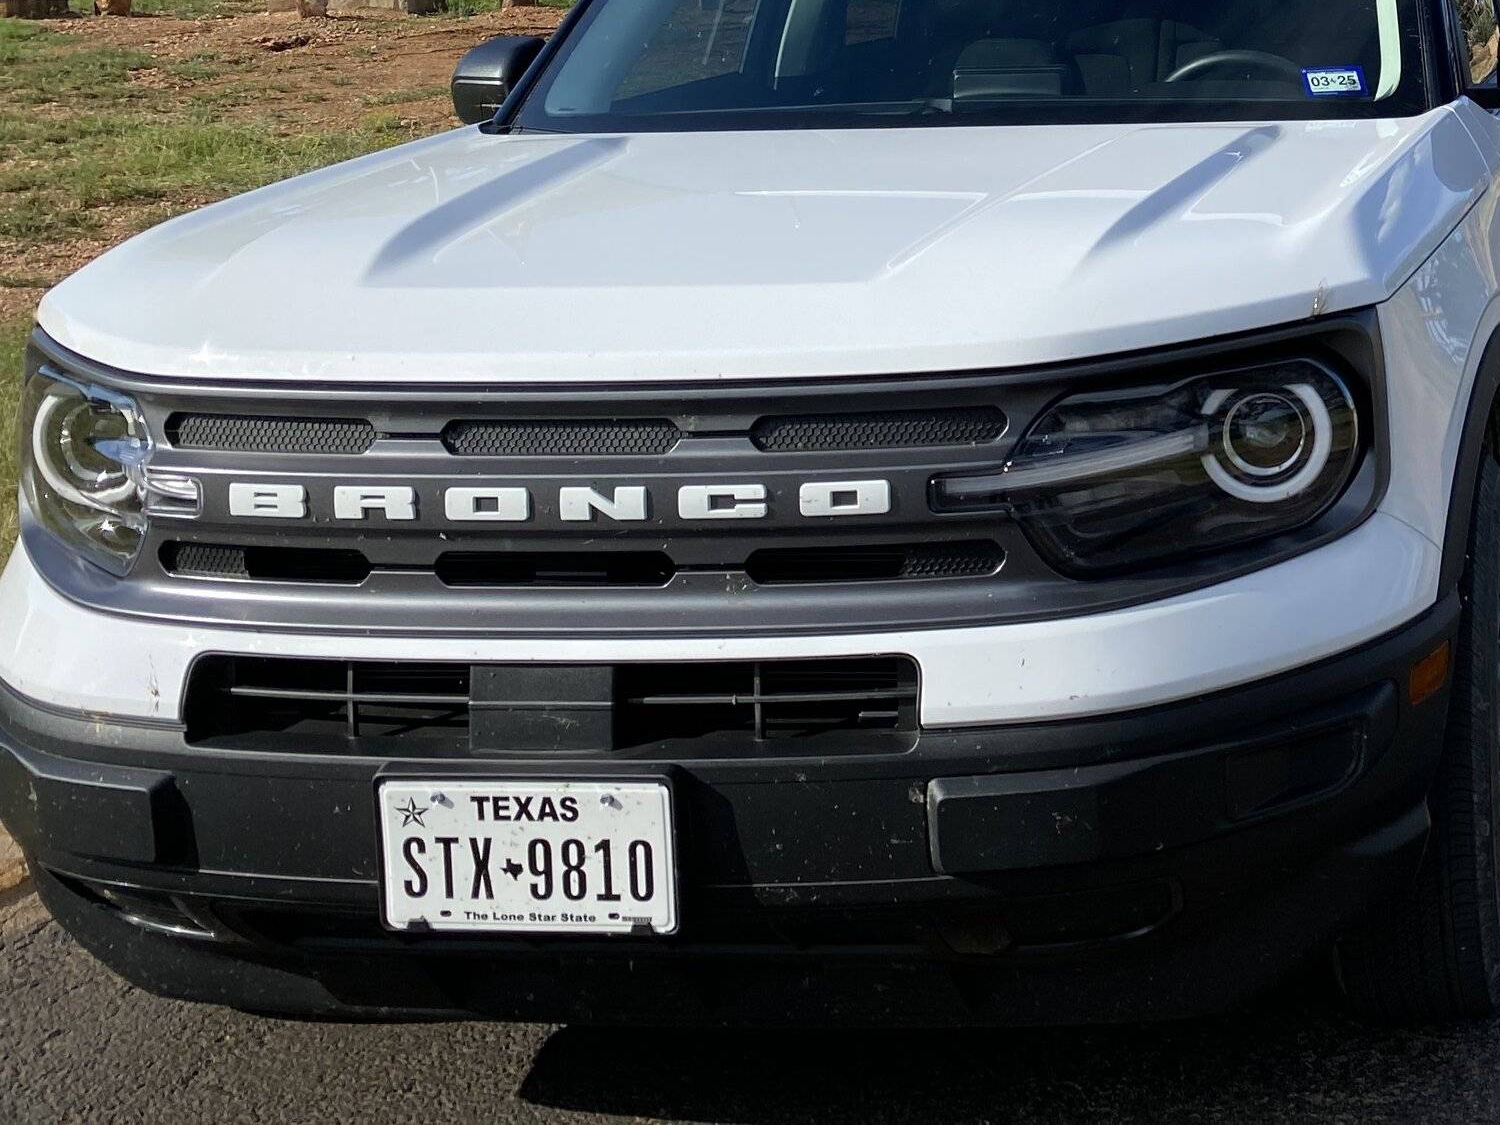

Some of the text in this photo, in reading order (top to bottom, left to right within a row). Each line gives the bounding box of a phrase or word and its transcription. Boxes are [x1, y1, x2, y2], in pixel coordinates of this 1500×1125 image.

[1311, 75, 1357, 86] 03 25
[227, 477, 894, 523] BRONCO
[470, 796, 579, 822] TEXAS
[402, 836, 655, 902] STX 9810
[464, 911, 597, 923] The Lone Star State
